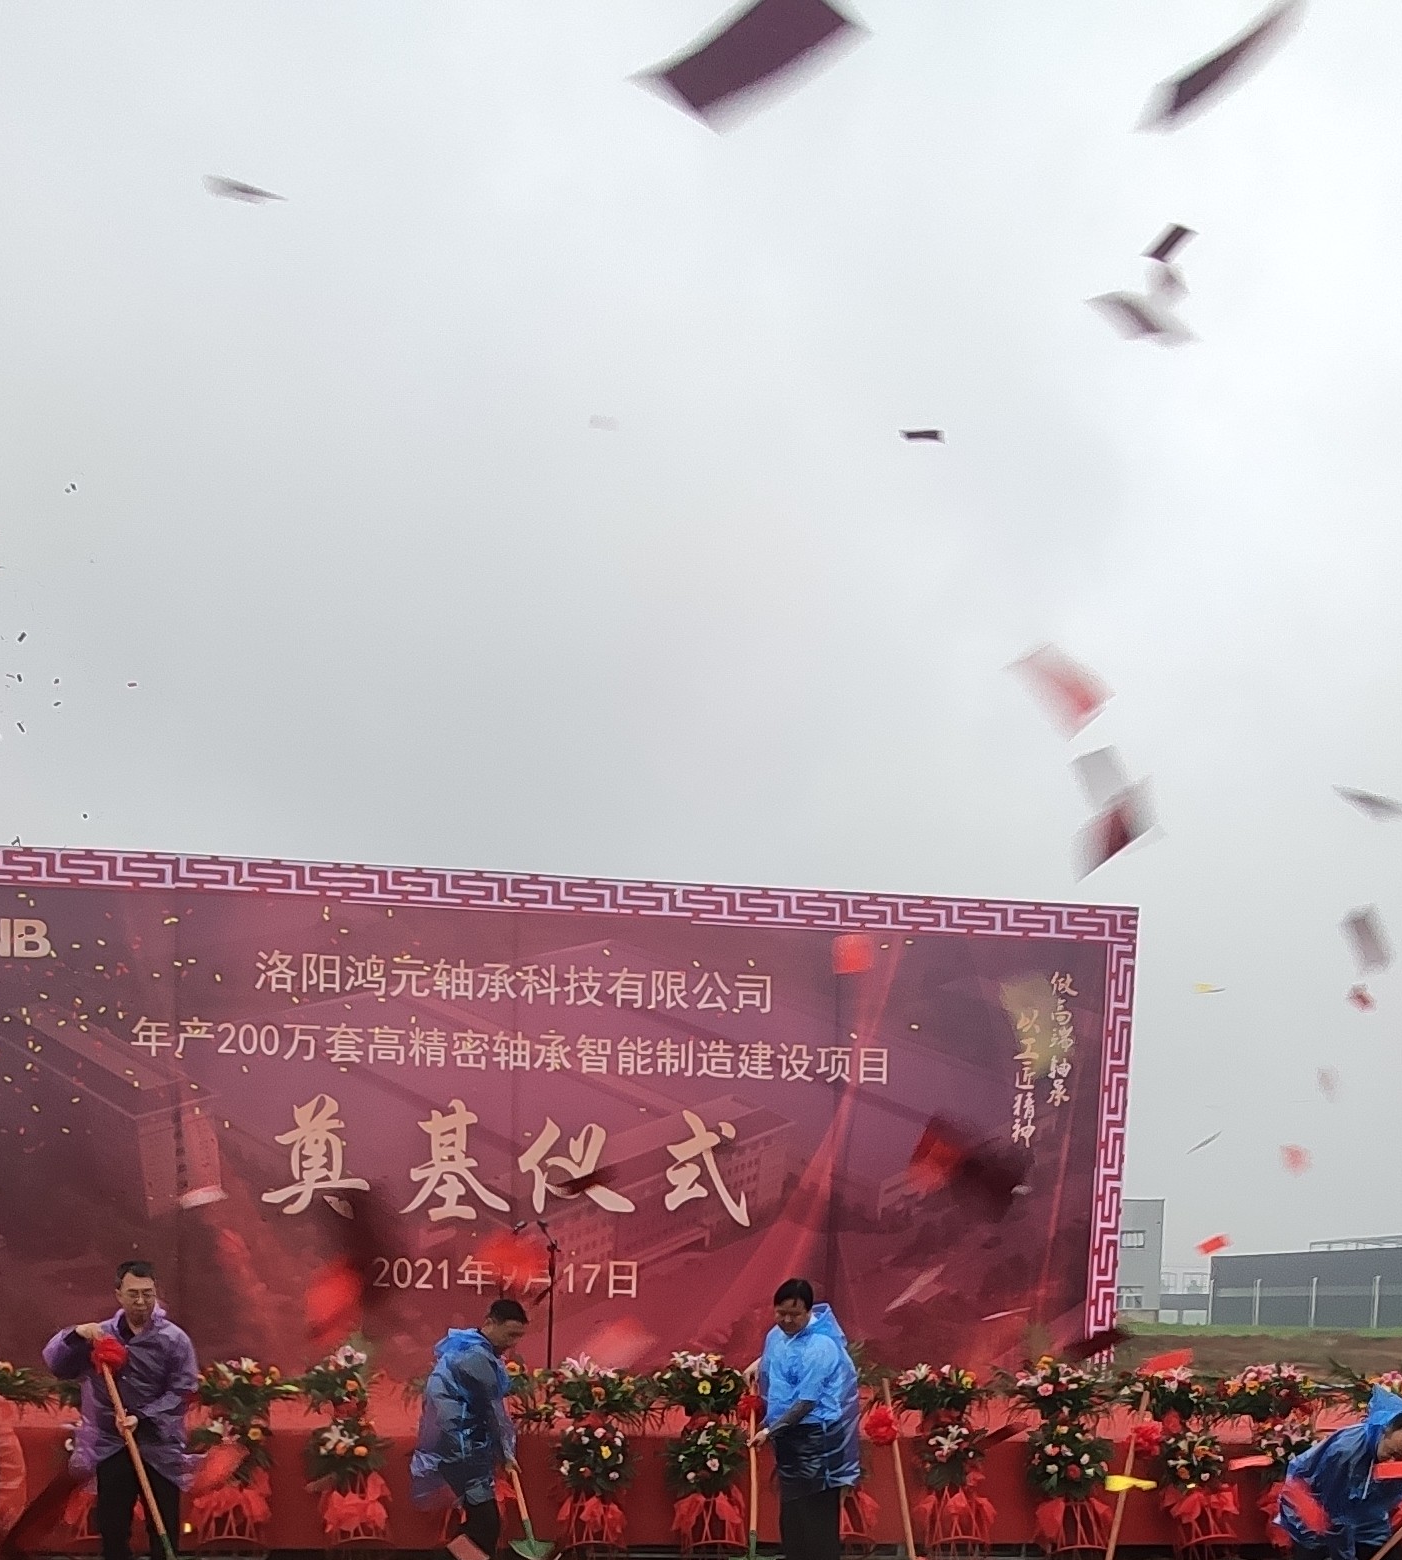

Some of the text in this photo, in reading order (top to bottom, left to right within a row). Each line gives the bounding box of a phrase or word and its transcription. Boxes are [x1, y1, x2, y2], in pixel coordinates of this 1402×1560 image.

[254, 949, 772, 1012] 洛阳鸿元轴承科技有限公司
[1046, 970, 1079, 1108] 做高端轴承
[131, 1016, 889, 1084] 年产200万套高精密轴承智能制造建设项目
[1011, 1009, 1041, 1149] 以工匠精神
[261, 1093, 751, 1227] 奠基仪式
